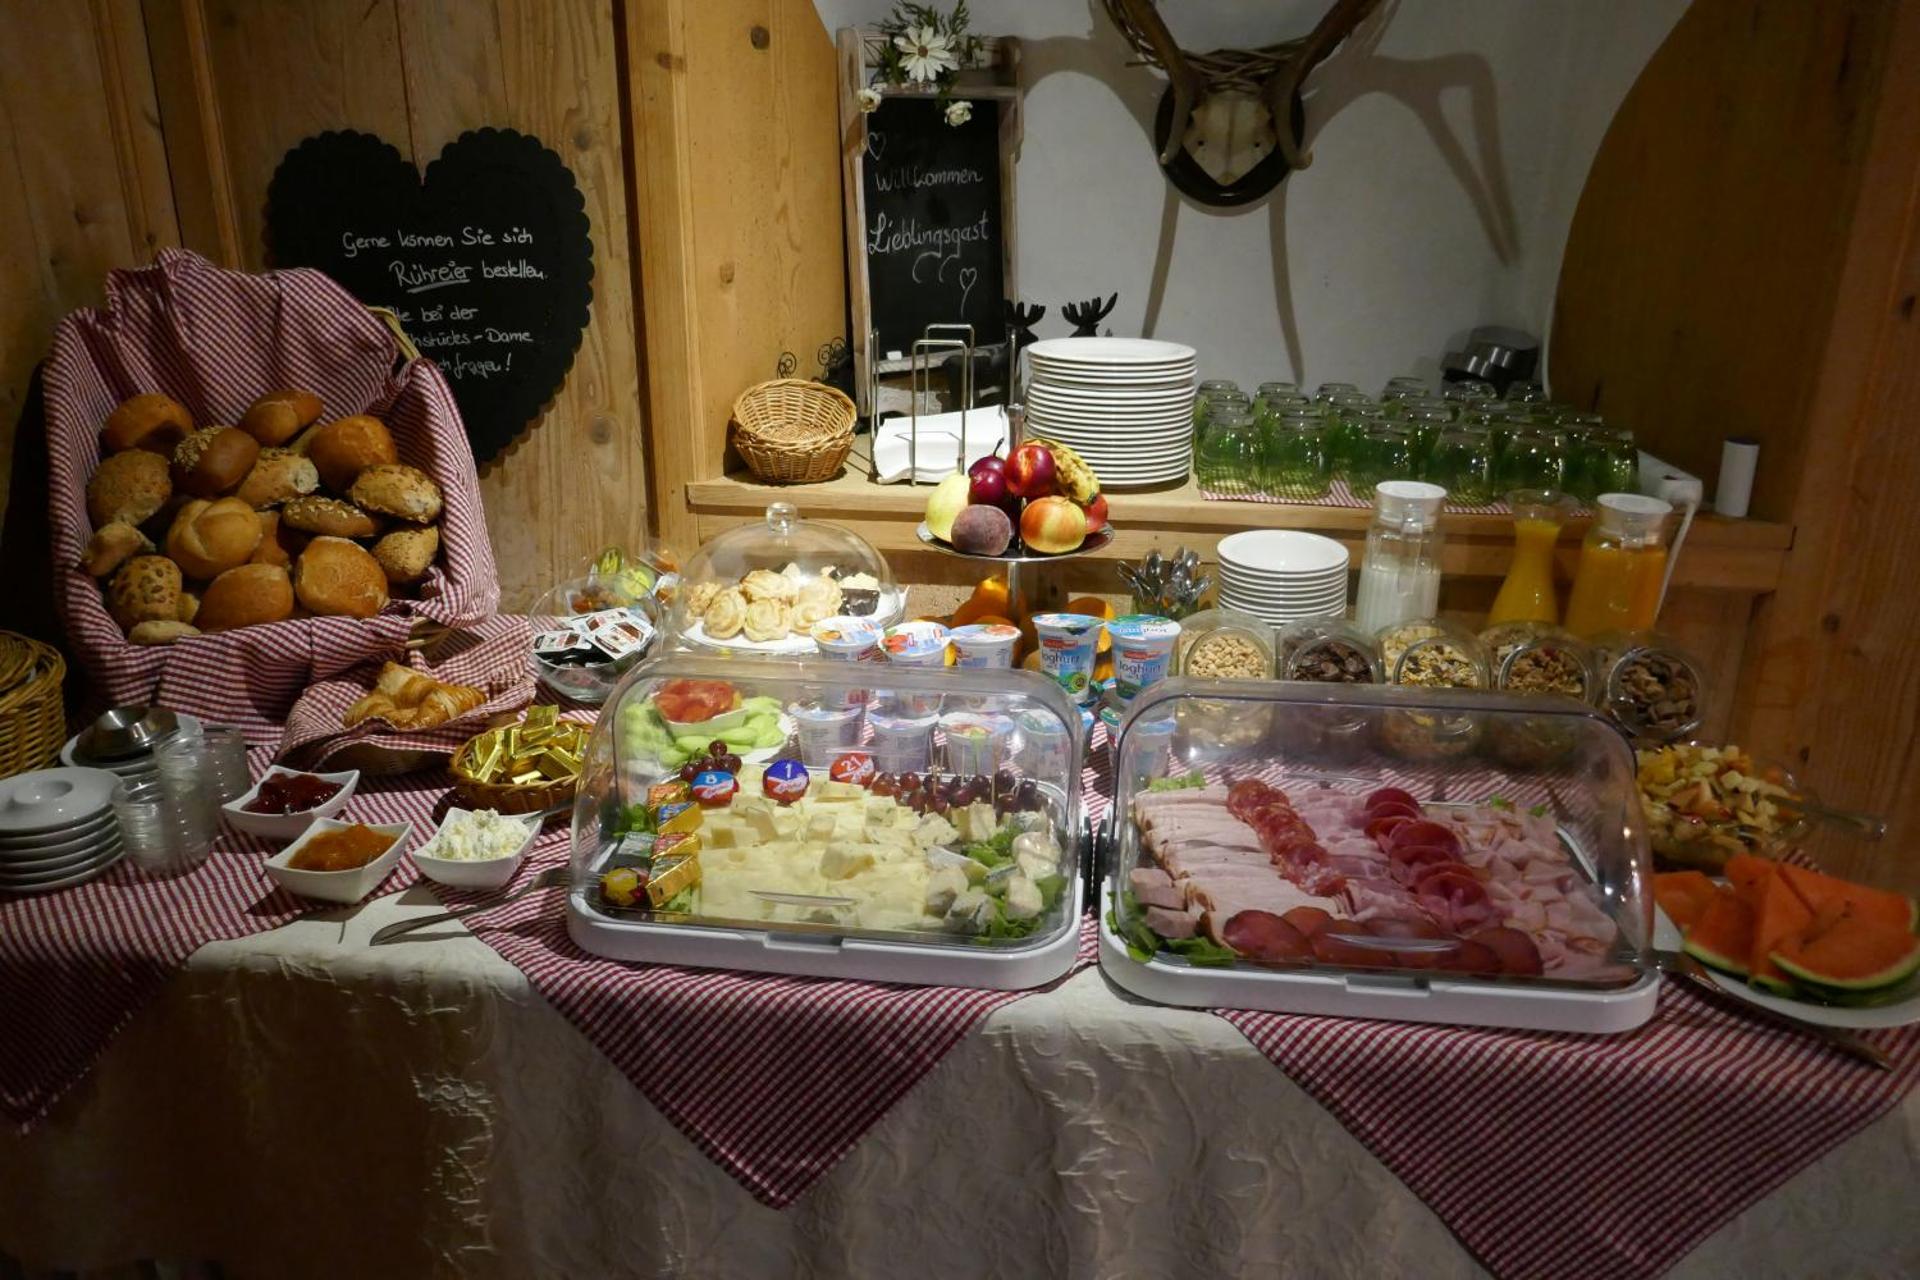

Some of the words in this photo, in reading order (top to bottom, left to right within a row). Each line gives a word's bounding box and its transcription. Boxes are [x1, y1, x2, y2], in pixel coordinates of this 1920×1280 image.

[875, 166, 984, 192] Willkommen
[342, 231, 391, 258] Gerne
[397, 229, 455, 248] können
[461, 226, 496, 246] Sie
[502, 226, 534, 245] sich
[868, 209, 990, 283] Lieblingsgast
[389, 260, 474, 288] Rühreier
[421, 304, 444, 322] bei
[450, 305, 479, 321] der
